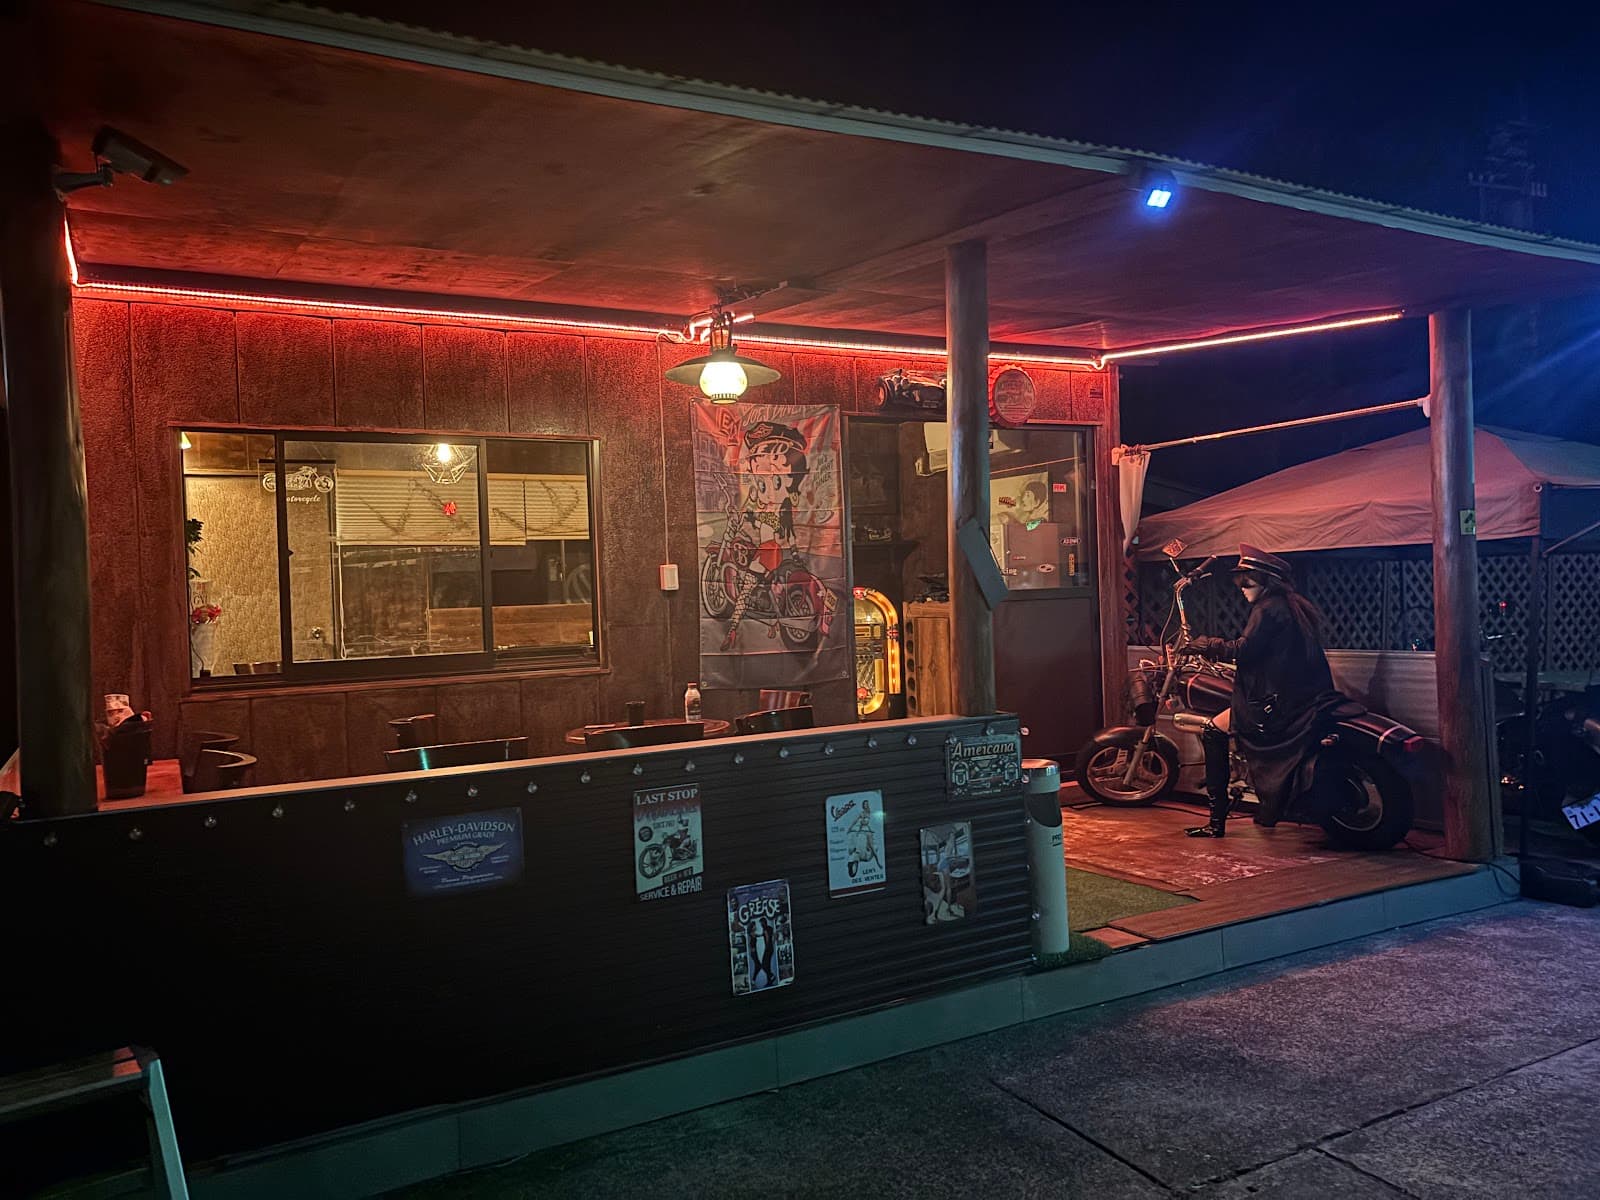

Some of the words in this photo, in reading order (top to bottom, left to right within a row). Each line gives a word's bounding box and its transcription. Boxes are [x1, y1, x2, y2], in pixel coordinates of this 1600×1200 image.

[286, 495, 320, 504] otorcycle
[636, 793, 666, 806] LAST
[668, 788, 698, 801] STOP
[413, 821, 515, 846] HARLEY-DAVIDSON
[437, 833, 472, 846] PREMIUM
[472, 831, 496, 841] GRADE
[640, 886, 670, 901] SERVICE
[671, 883, 678, 896] &
[677, 876, 702, 895] REPAIR
[738, 898, 781, 925] GREASE
